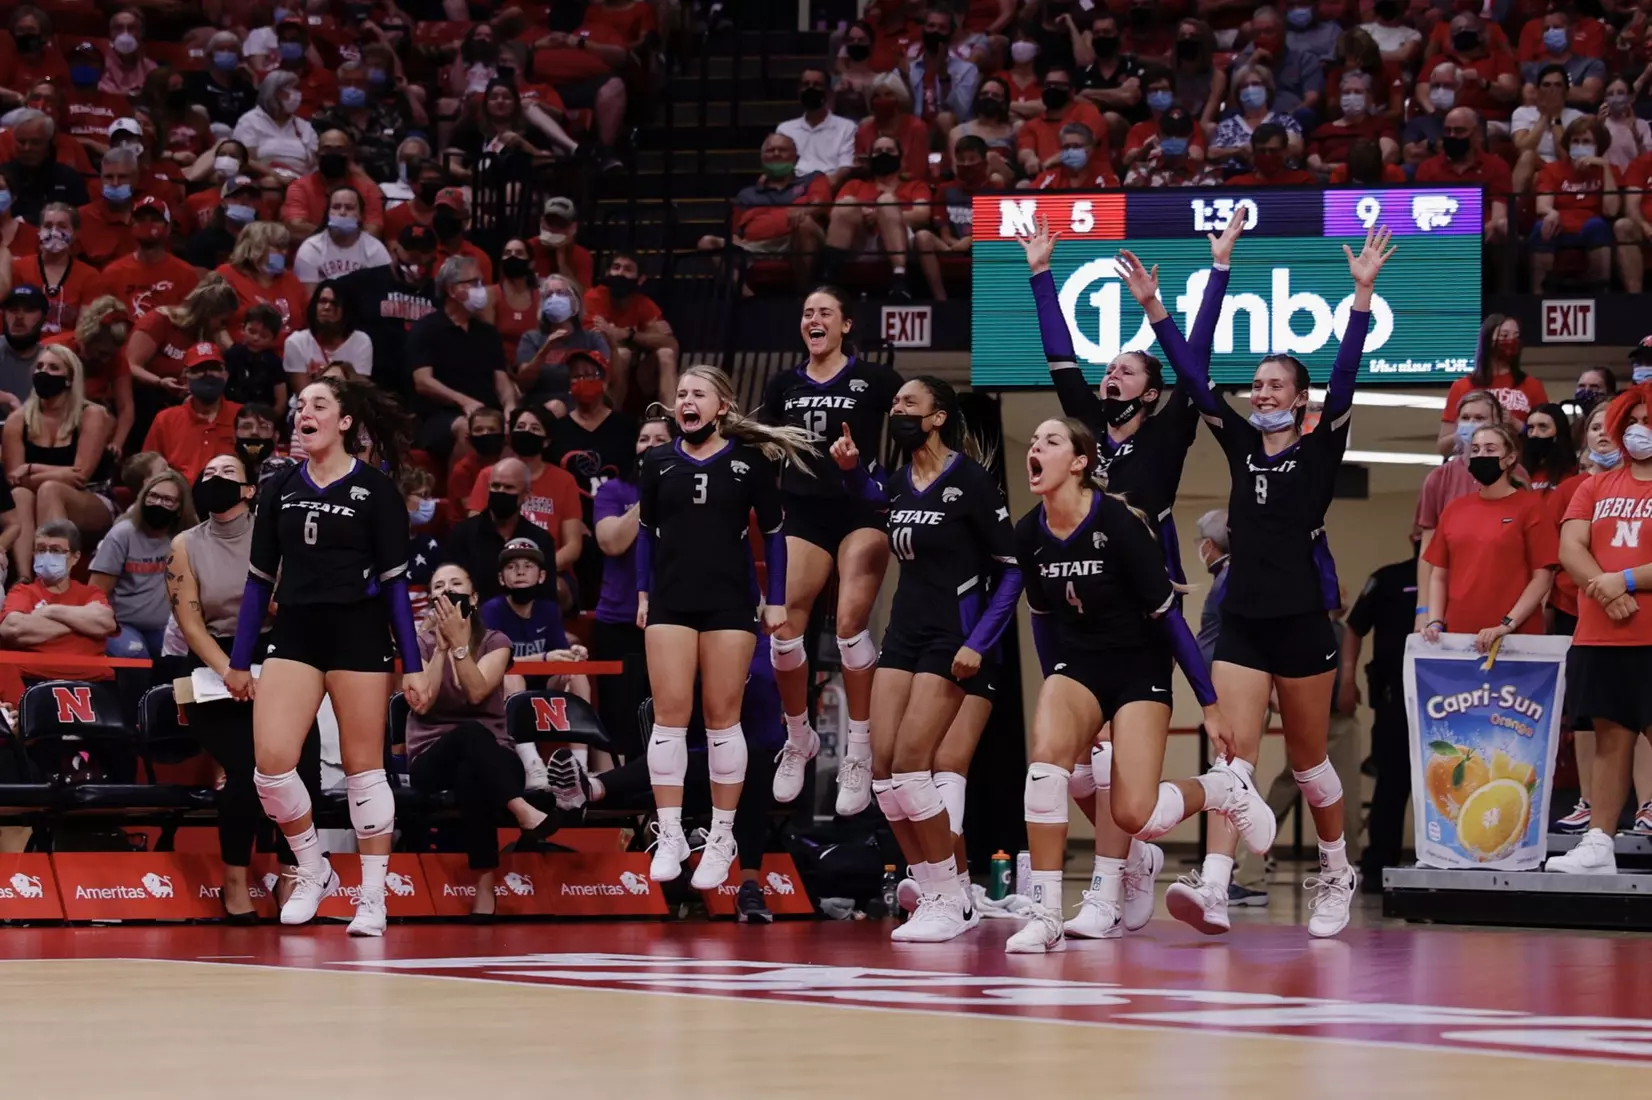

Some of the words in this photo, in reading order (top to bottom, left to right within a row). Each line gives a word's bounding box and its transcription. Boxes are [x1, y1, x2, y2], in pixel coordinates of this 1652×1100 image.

[999, 200, 1036, 237] N
[1070, 201, 1095, 232] 5
[1190, 199, 1258, 230] 1:30
[1356, 198, 1380, 229] 9
[1173, 268, 1393, 353] fnbo
[1546, 306, 1591, 336] EXIT
[886, 312, 928, 341] EXIT
[785, 396, 858, 410] K-STATE
[803, 411, 828, 441] 12
[693, 473, 709, 504] 3
[1255, 475, 1269, 504] 8
[304, 511, 319, 545] 6
[892, 527, 915, 560] 10
[1611, 521, 1640, 547] N
[1065, 580, 1084, 614] 4
[52, 686, 96, 723] N
[531, 697, 571, 731] N
[1427, 684, 1544, 720] Capri-Sun
[76, 885, 146, 899] Ameritas
[443, 884, 508, 896] Ameas
[561, 884, 624, 897] Ameritas
[884, 893, 894, 905] G
